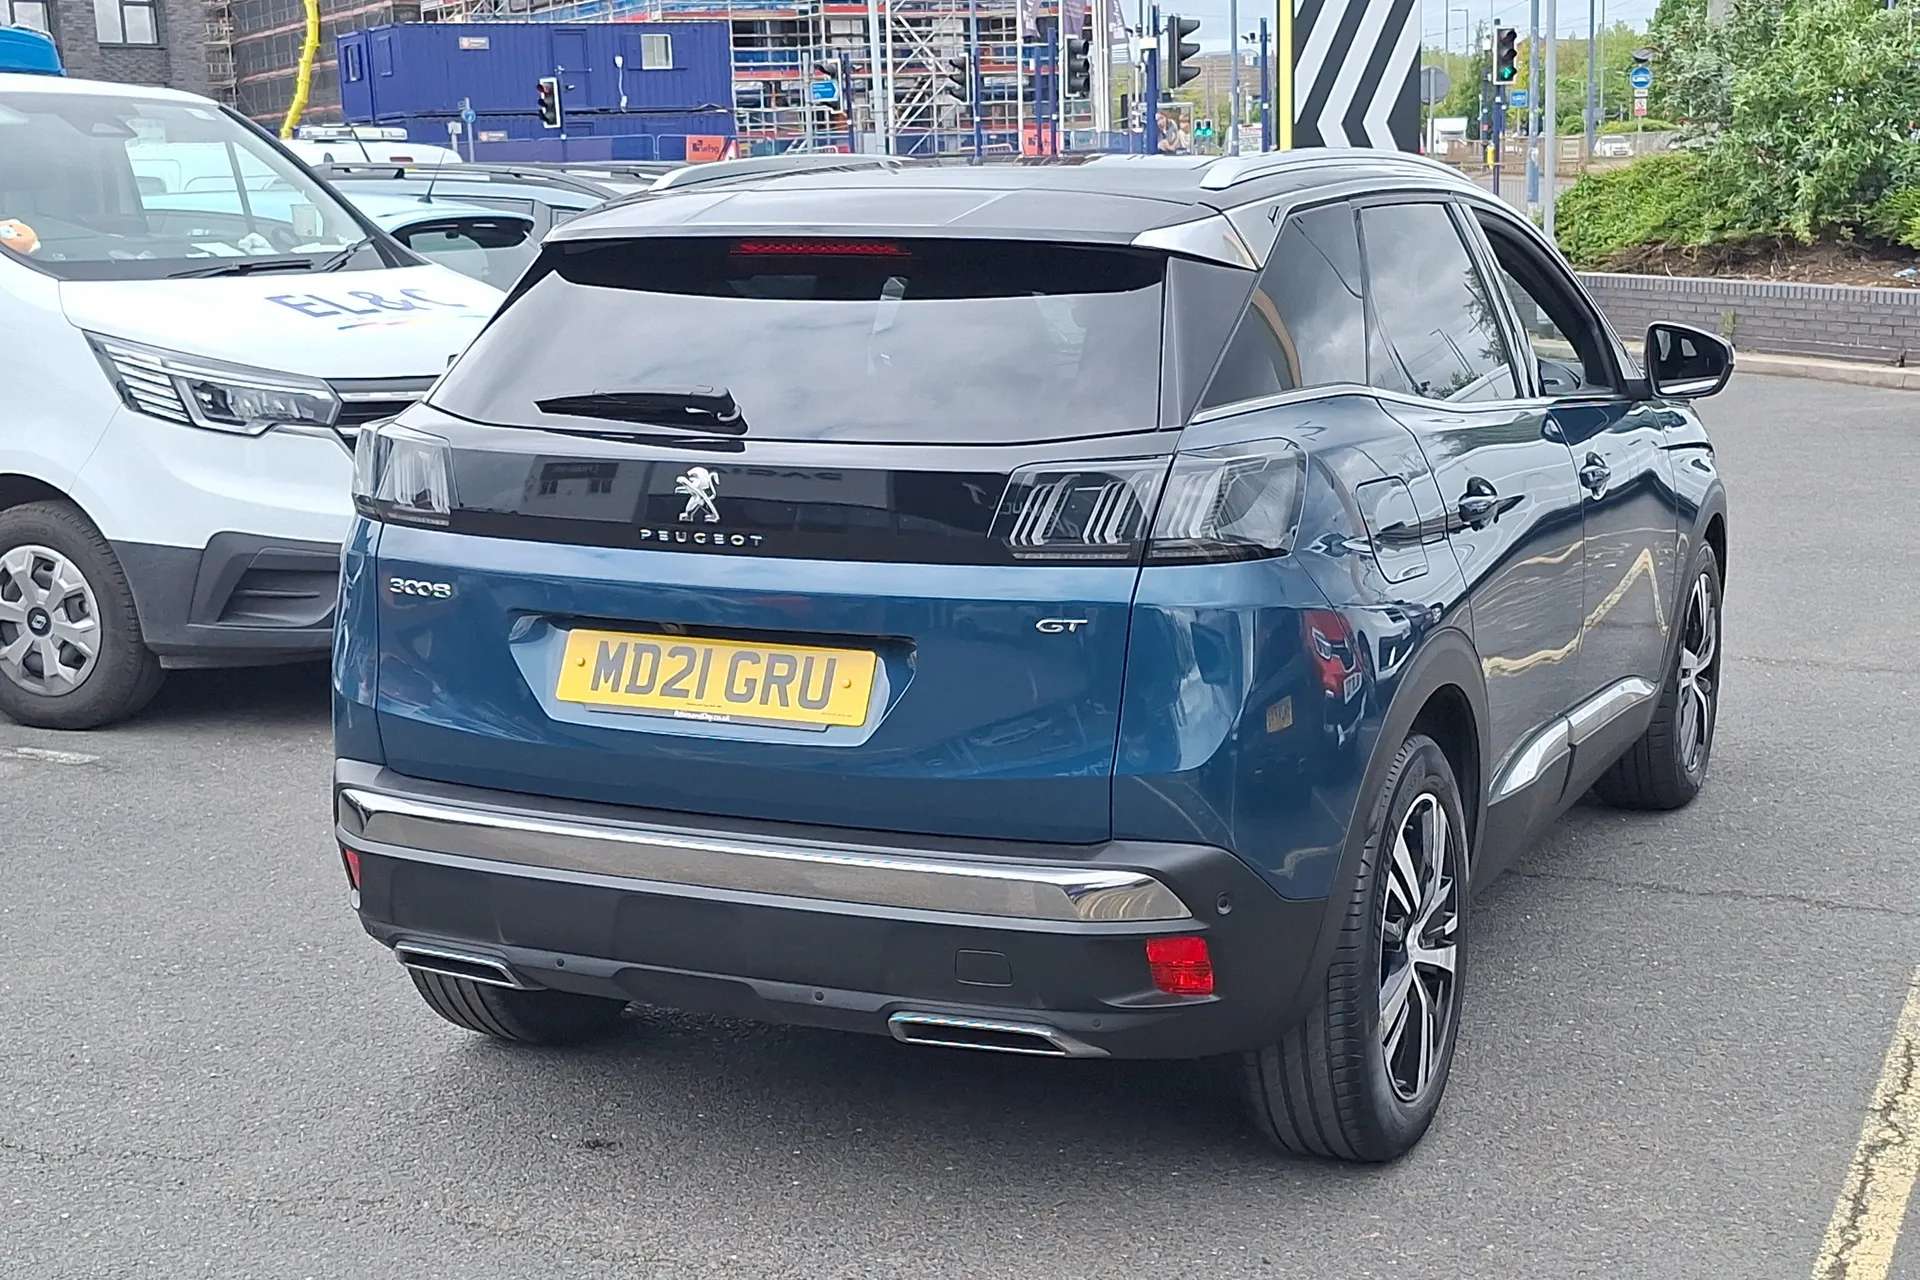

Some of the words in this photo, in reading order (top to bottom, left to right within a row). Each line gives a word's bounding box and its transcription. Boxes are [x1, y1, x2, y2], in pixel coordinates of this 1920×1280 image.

[640, 528, 763, 546] PEUGEOT
[389, 577, 452, 598] 3008
[1035, 618, 1088, 633] GT
[590, 640, 713, 700] MD21
[724, 650, 837, 710] GRU
